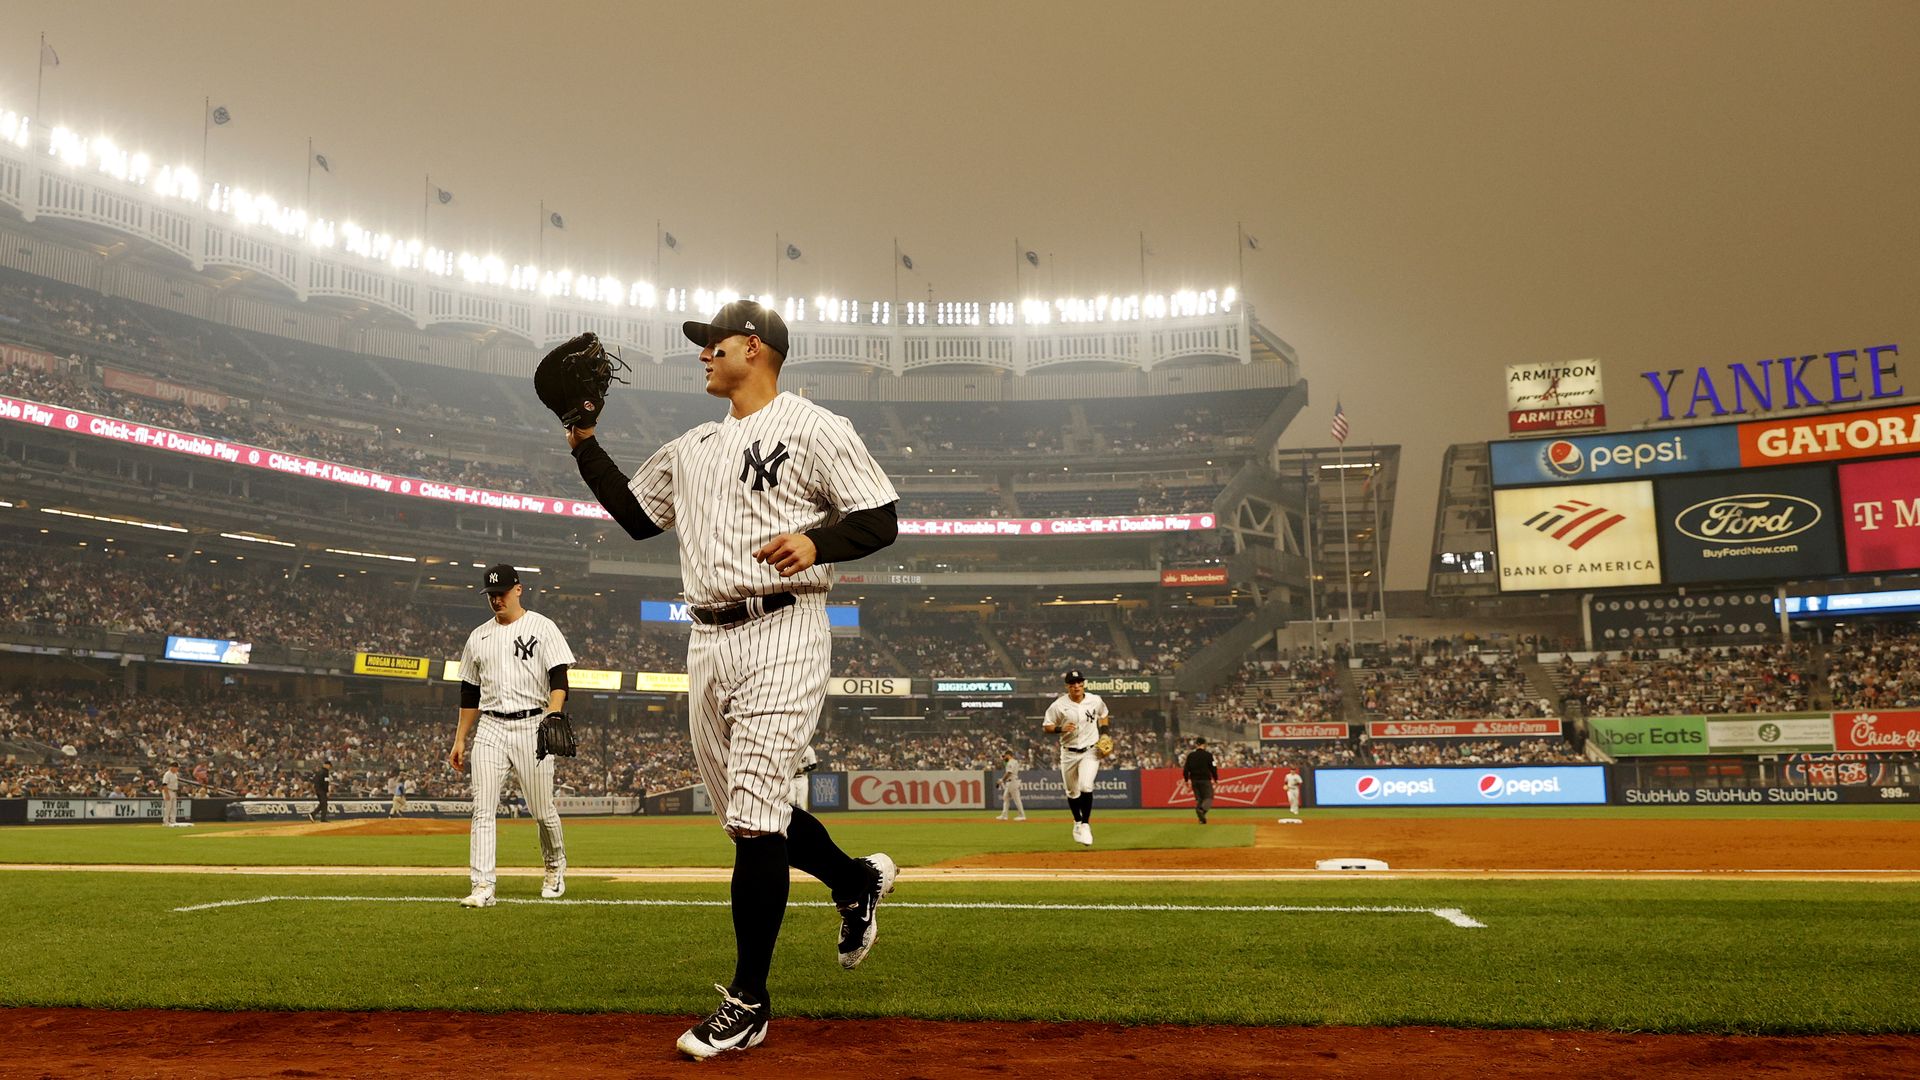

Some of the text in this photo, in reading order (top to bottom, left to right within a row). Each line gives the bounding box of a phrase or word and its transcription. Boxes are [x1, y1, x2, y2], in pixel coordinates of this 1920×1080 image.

[1510, 365, 1596, 382] ARMITRON
[1641, 344, 1904, 421] YANKEE
[156, 382, 221, 409] PARTY DECK
[22, 404, 54, 427] Play
[1517, 408, 1595, 424] ARMITRON
[168, 433, 212, 457] Double
[214, 442, 239, 463] Play
[1590, 436, 1682, 472] pepsi
[739, 439, 790, 491] NY
[332, 466, 369, 486] Double
[370, 474, 392, 492] Play
[482, 491, 520, 510] Double
[522, 496, 545, 513] Play
[1121, 518, 1163, 531] Double
[1165, 517, 1190, 530] Play
[1701, 501, 1794, 536] Ford
[898, 521, 1021, 535] hick-fil-A Double Play
[1703, 544, 1798, 558] BuyFordNow.com
[1503, 560, 1655, 577] BANK OF AMERICA
[839, 575, 864, 583] Audi
[902, 575, 921, 584] CLUB
[1180, 573, 1225, 583] Budweiser
[514, 635, 538, 661] NY
[367, 656, 391, 667] MORGAN
[396, 658, 419, 669] MORGAN
[843, 679, 895, 694] ORIS
[989, 682, 1013, 691] TEA
[1115, 678, 1151, 693] Spring
[1650, 728, 1702, 744] Eats
[816, 777, 833, 786] NEW
[1383, 777, 1559, 797] pepsi pepsi
[814, 785, 837, 795] YORK
[851, 775, 982, 805] Canon
[1625, 788, 1838, 803] StubHub StubHub StubHub
[1881, 787, 1902, 798] 399
[42, 801, 70, 809] TRY OUR
[816, 794, 835, 803] LIFE
[36, 808, 76, 818] SOFT SERVE!
[265, 804, 292, 814] COOL
[361, 803, 385, 812] COOL
[411, 802, 434, 812] COOL
